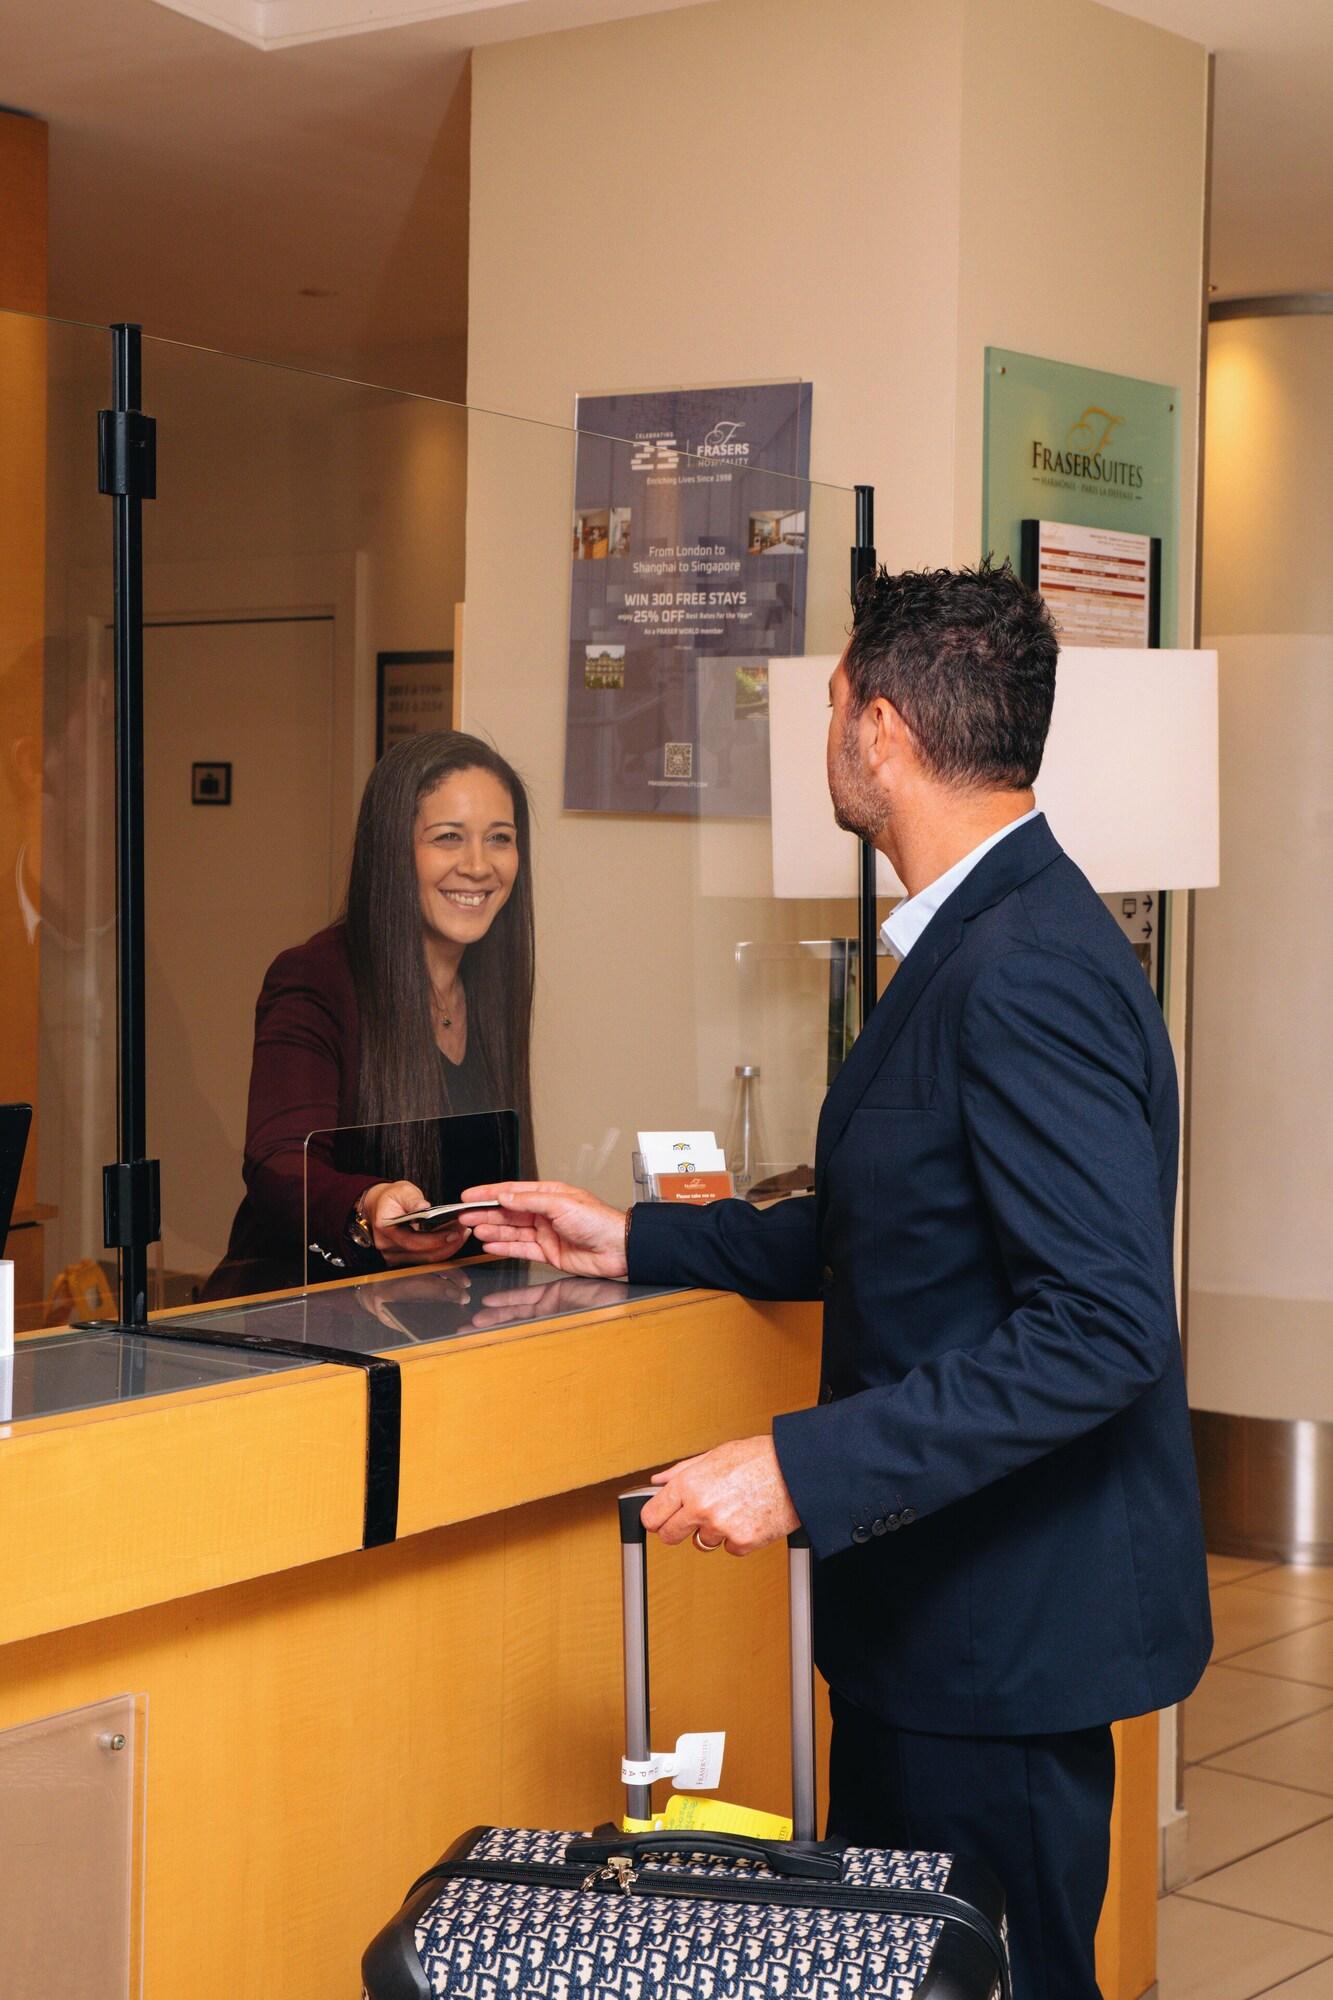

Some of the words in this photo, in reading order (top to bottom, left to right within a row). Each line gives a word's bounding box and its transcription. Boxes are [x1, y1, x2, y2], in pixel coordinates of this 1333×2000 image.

[697, 443, 750, 457] FRASERS
[678, 476, 695, 484] Lives
[696, 475, 714, 483] Since
[649, 546, 674, 557] From
[676, 545, 712, 557] London
[715, 545, 726, 556] to
[632, 562, 677, 575] Shanghai
[679, 561, 689, 572] to
[691, 560, 741, 575] Singapore
[625, 594, 649, 607] WIN
[651, 593, 673, 606] 300
[676, 593, 707, 606] FREE
[708, 592, 747, 605] STAYS
[633, 611, 660, 623] 25%
[661, 610, 685, 623] OFF
[725, 612, 736, 620] the
